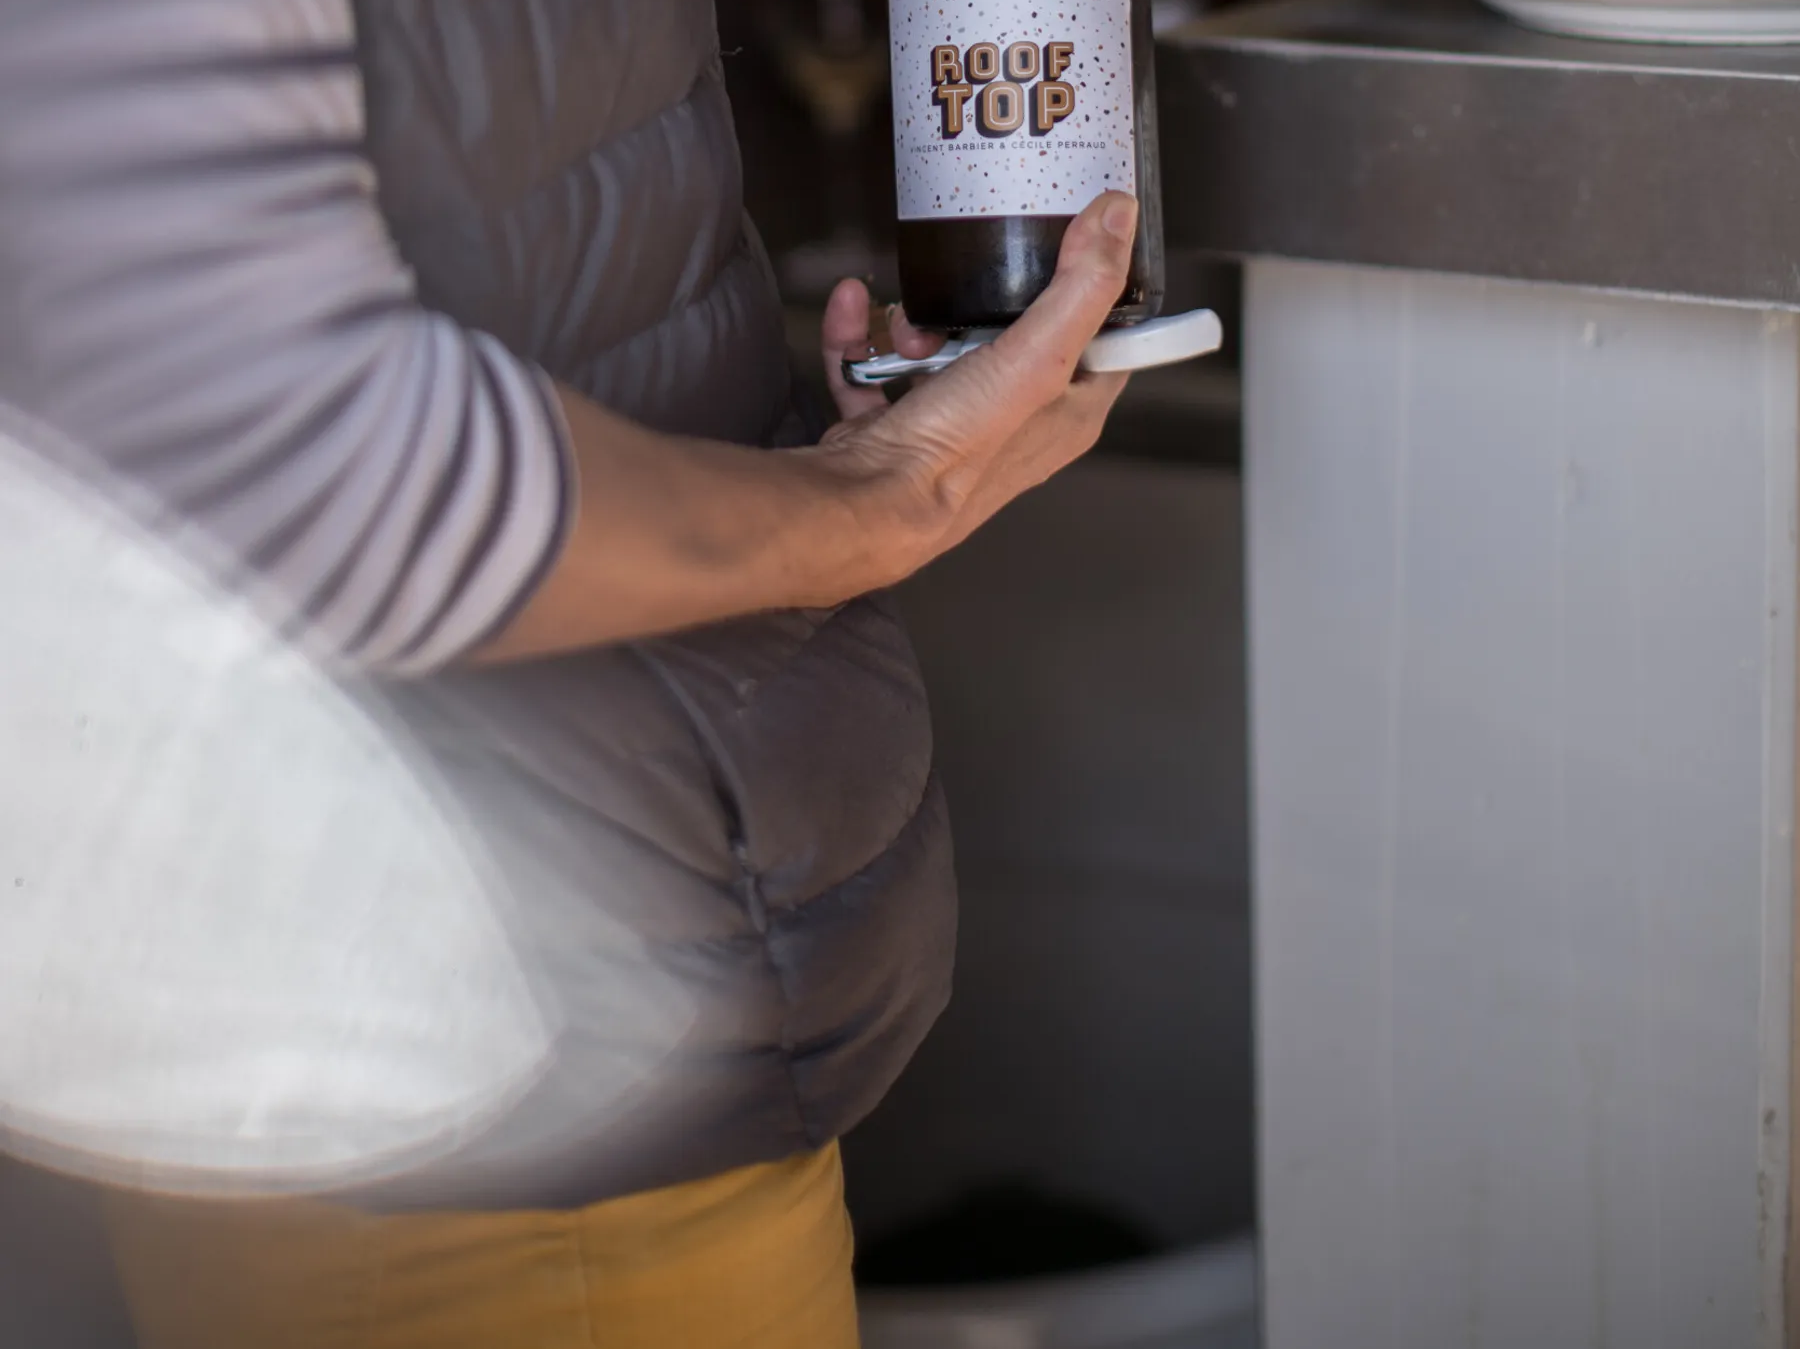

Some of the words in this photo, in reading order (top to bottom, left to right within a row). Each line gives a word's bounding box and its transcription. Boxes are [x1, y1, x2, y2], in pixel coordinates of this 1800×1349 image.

[931, 41, 1075, 86] ROOF
[932, 81, 1075, 139] TOP
[948, 141, 994, 151] BARBIER
[999, 141, 1006, 149] &
[1011, 140, 1052, 149] CÉCILE
[1057, 140, 1106, 149] PERRAUD
